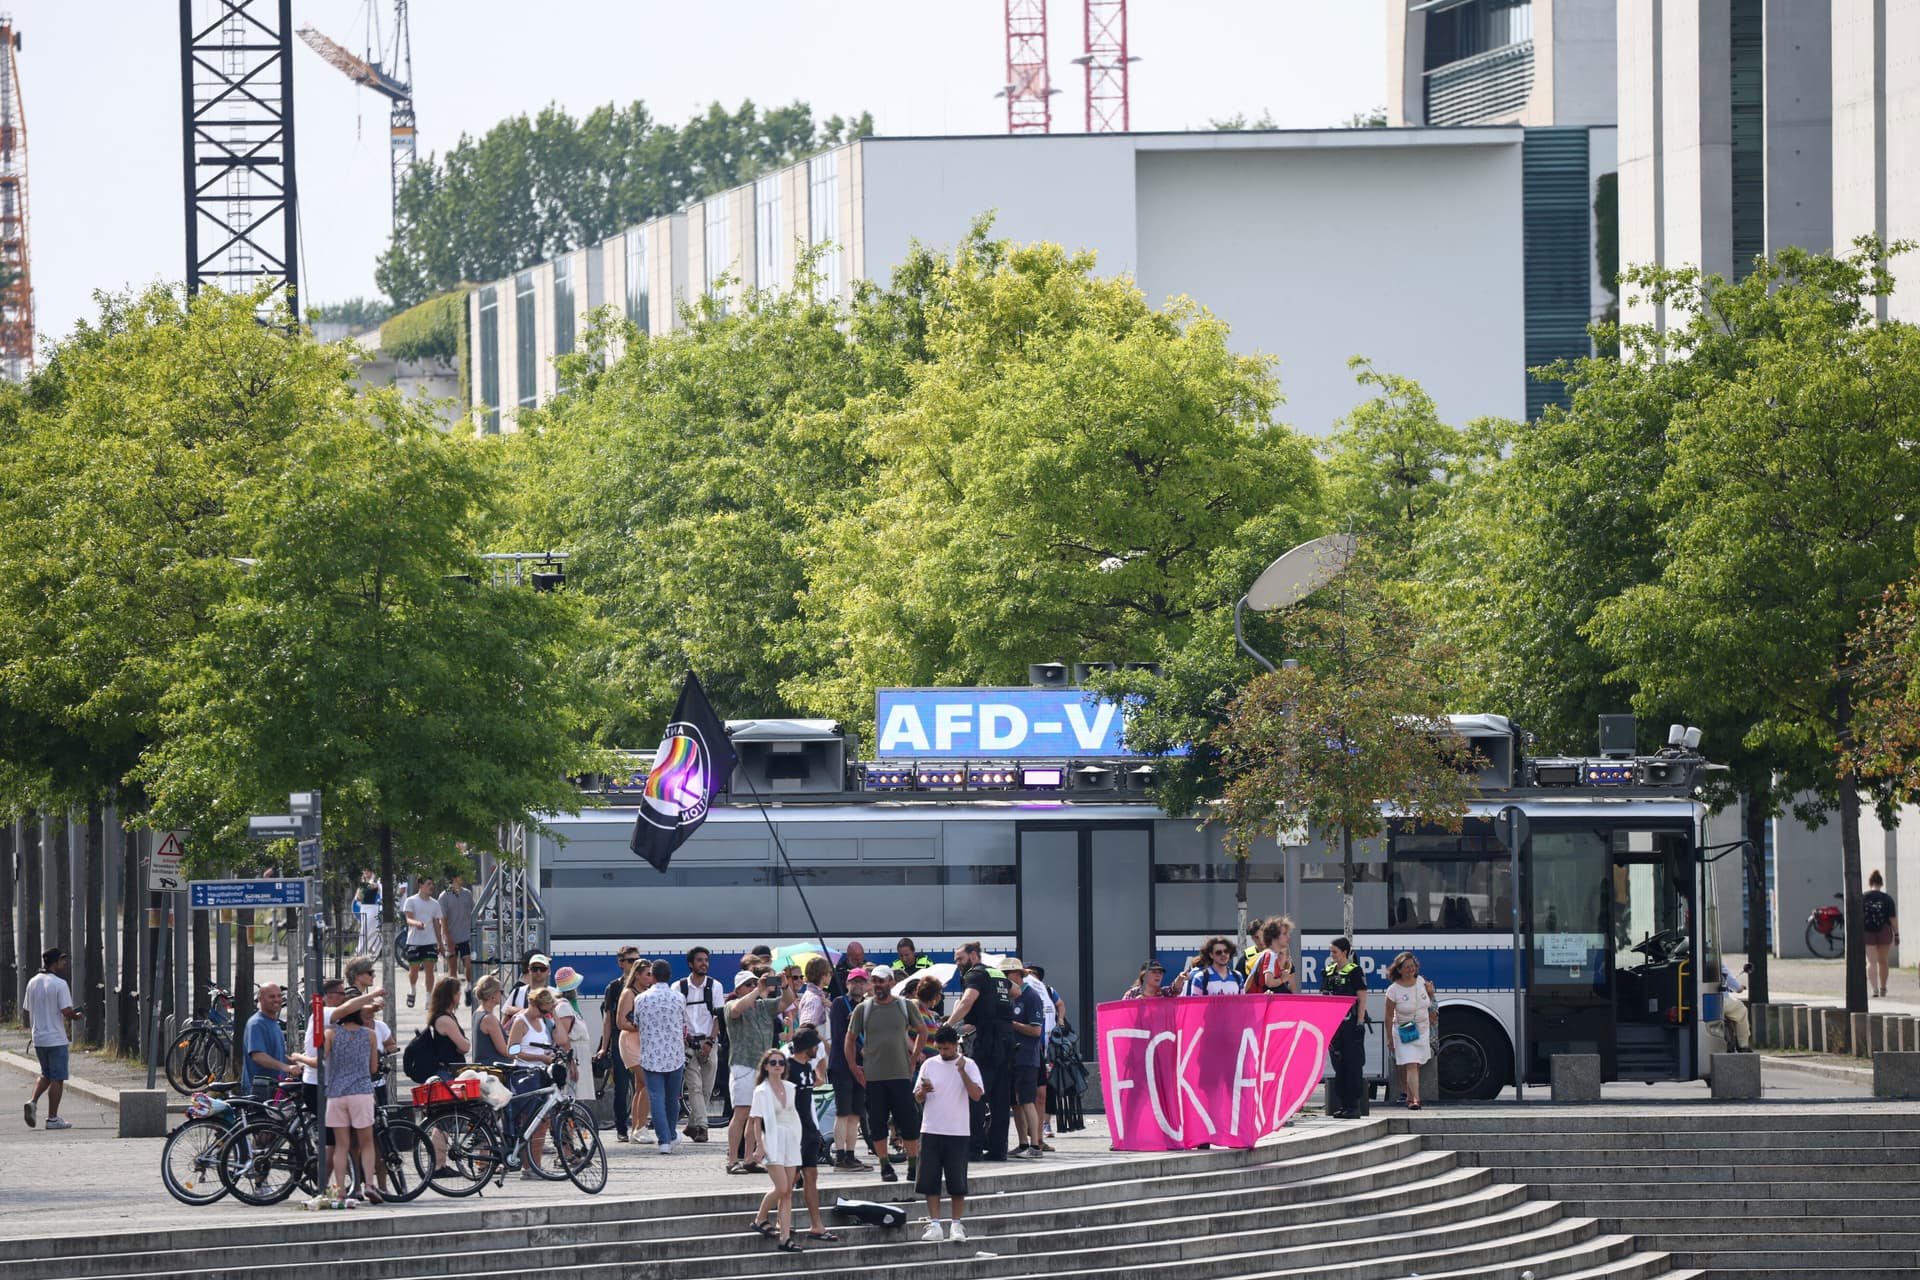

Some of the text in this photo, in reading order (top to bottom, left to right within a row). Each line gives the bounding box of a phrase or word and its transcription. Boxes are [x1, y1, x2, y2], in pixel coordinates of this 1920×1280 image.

[879, 703, 1127, 750] AFD-V
[1106, 1020, 1325, 1142] FCK AFD
